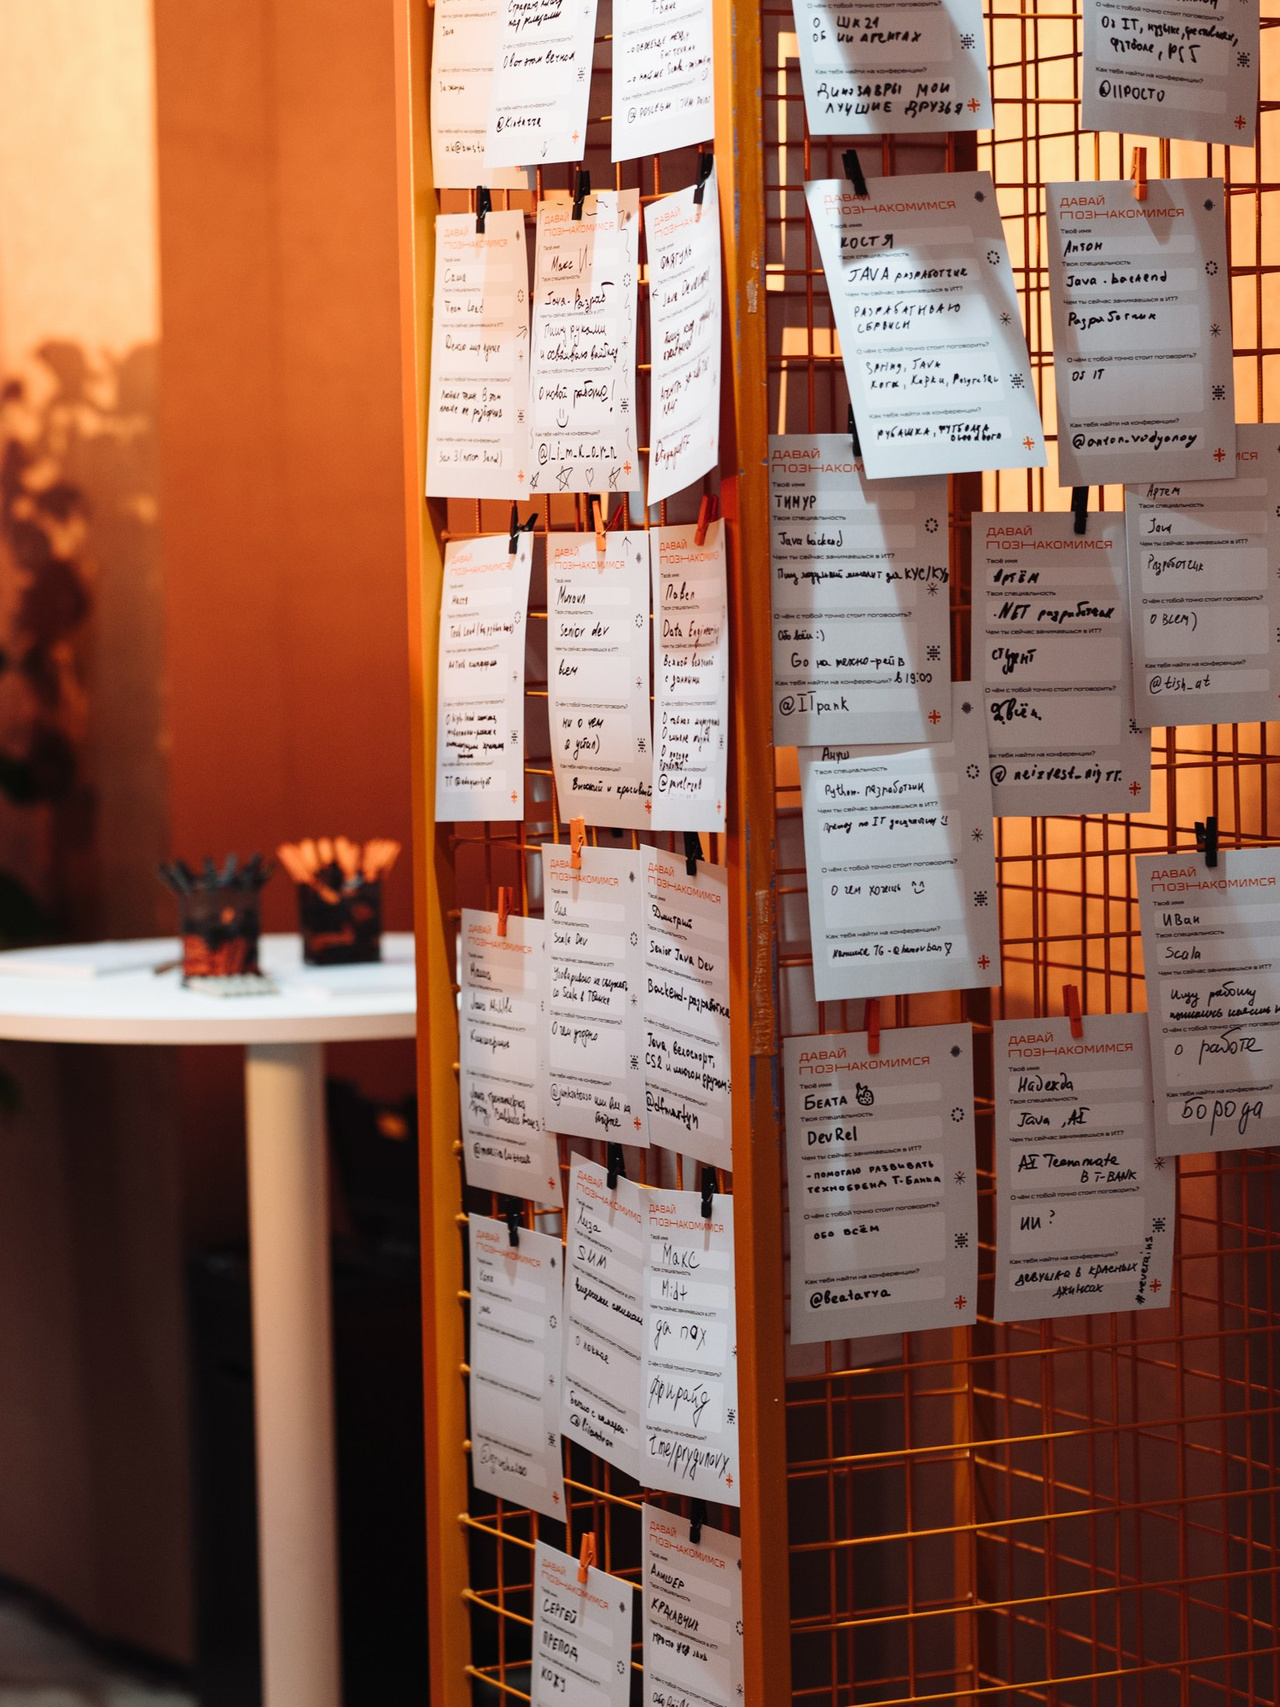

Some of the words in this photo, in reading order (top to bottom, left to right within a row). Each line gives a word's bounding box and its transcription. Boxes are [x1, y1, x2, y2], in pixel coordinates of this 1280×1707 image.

[825, 200, 957, 216] ПОЗНАКОМИМСЯ
[1059, 195, 1106, 209] ДАВАЙ
[1059, 208, 1185, 220] ПОЗНАКОМИМСЯ
[840, 234, 893, 249] КОСТЯ
[1063, 240, 1103, 257] Антон
[1066, 275, 1097, 288] Java
[1154, 352, 1197, 360] поговорить?
[771, 447, 821, 461] ДАВАЙ
[986, 525, 1033, 538] ДАВАЙ
[659, 538, 688, 552] ДАВАЙ
[986, 540, 1113, 550] ПОЗНАКОМИМСЯ
[647, 862, 675, 878] ДАВАЙ
[1150, 866, 1197, 882] ДАВАЙ
[647, 875, 721, 905] ПОЗНАКОМИМСЯ
[1151, 877, 1277, 893] ПОЗНАКОМИМСЯ
[1165, 946, 1201, 960] Scala
[1007, 1032, 1054, 1047] ДАВАЙ
[799, 1047, 847, 1064] ДАВАЙ
[1007, 1042, 1134, 1059] ПОЗНАКОМИМСЯ
[798, 1055, 931, 1076] ПОЗНАКОМИМСЯ
[1018, 1072, 1074, 1093] Надежда
[648, 1203, 677, 1215] ДАВАЙ
[649, 1520, 678, 1538] ДАВАЙ
[649, 1533, 726, 1570] ПОЗНАКОМИМСЯ
